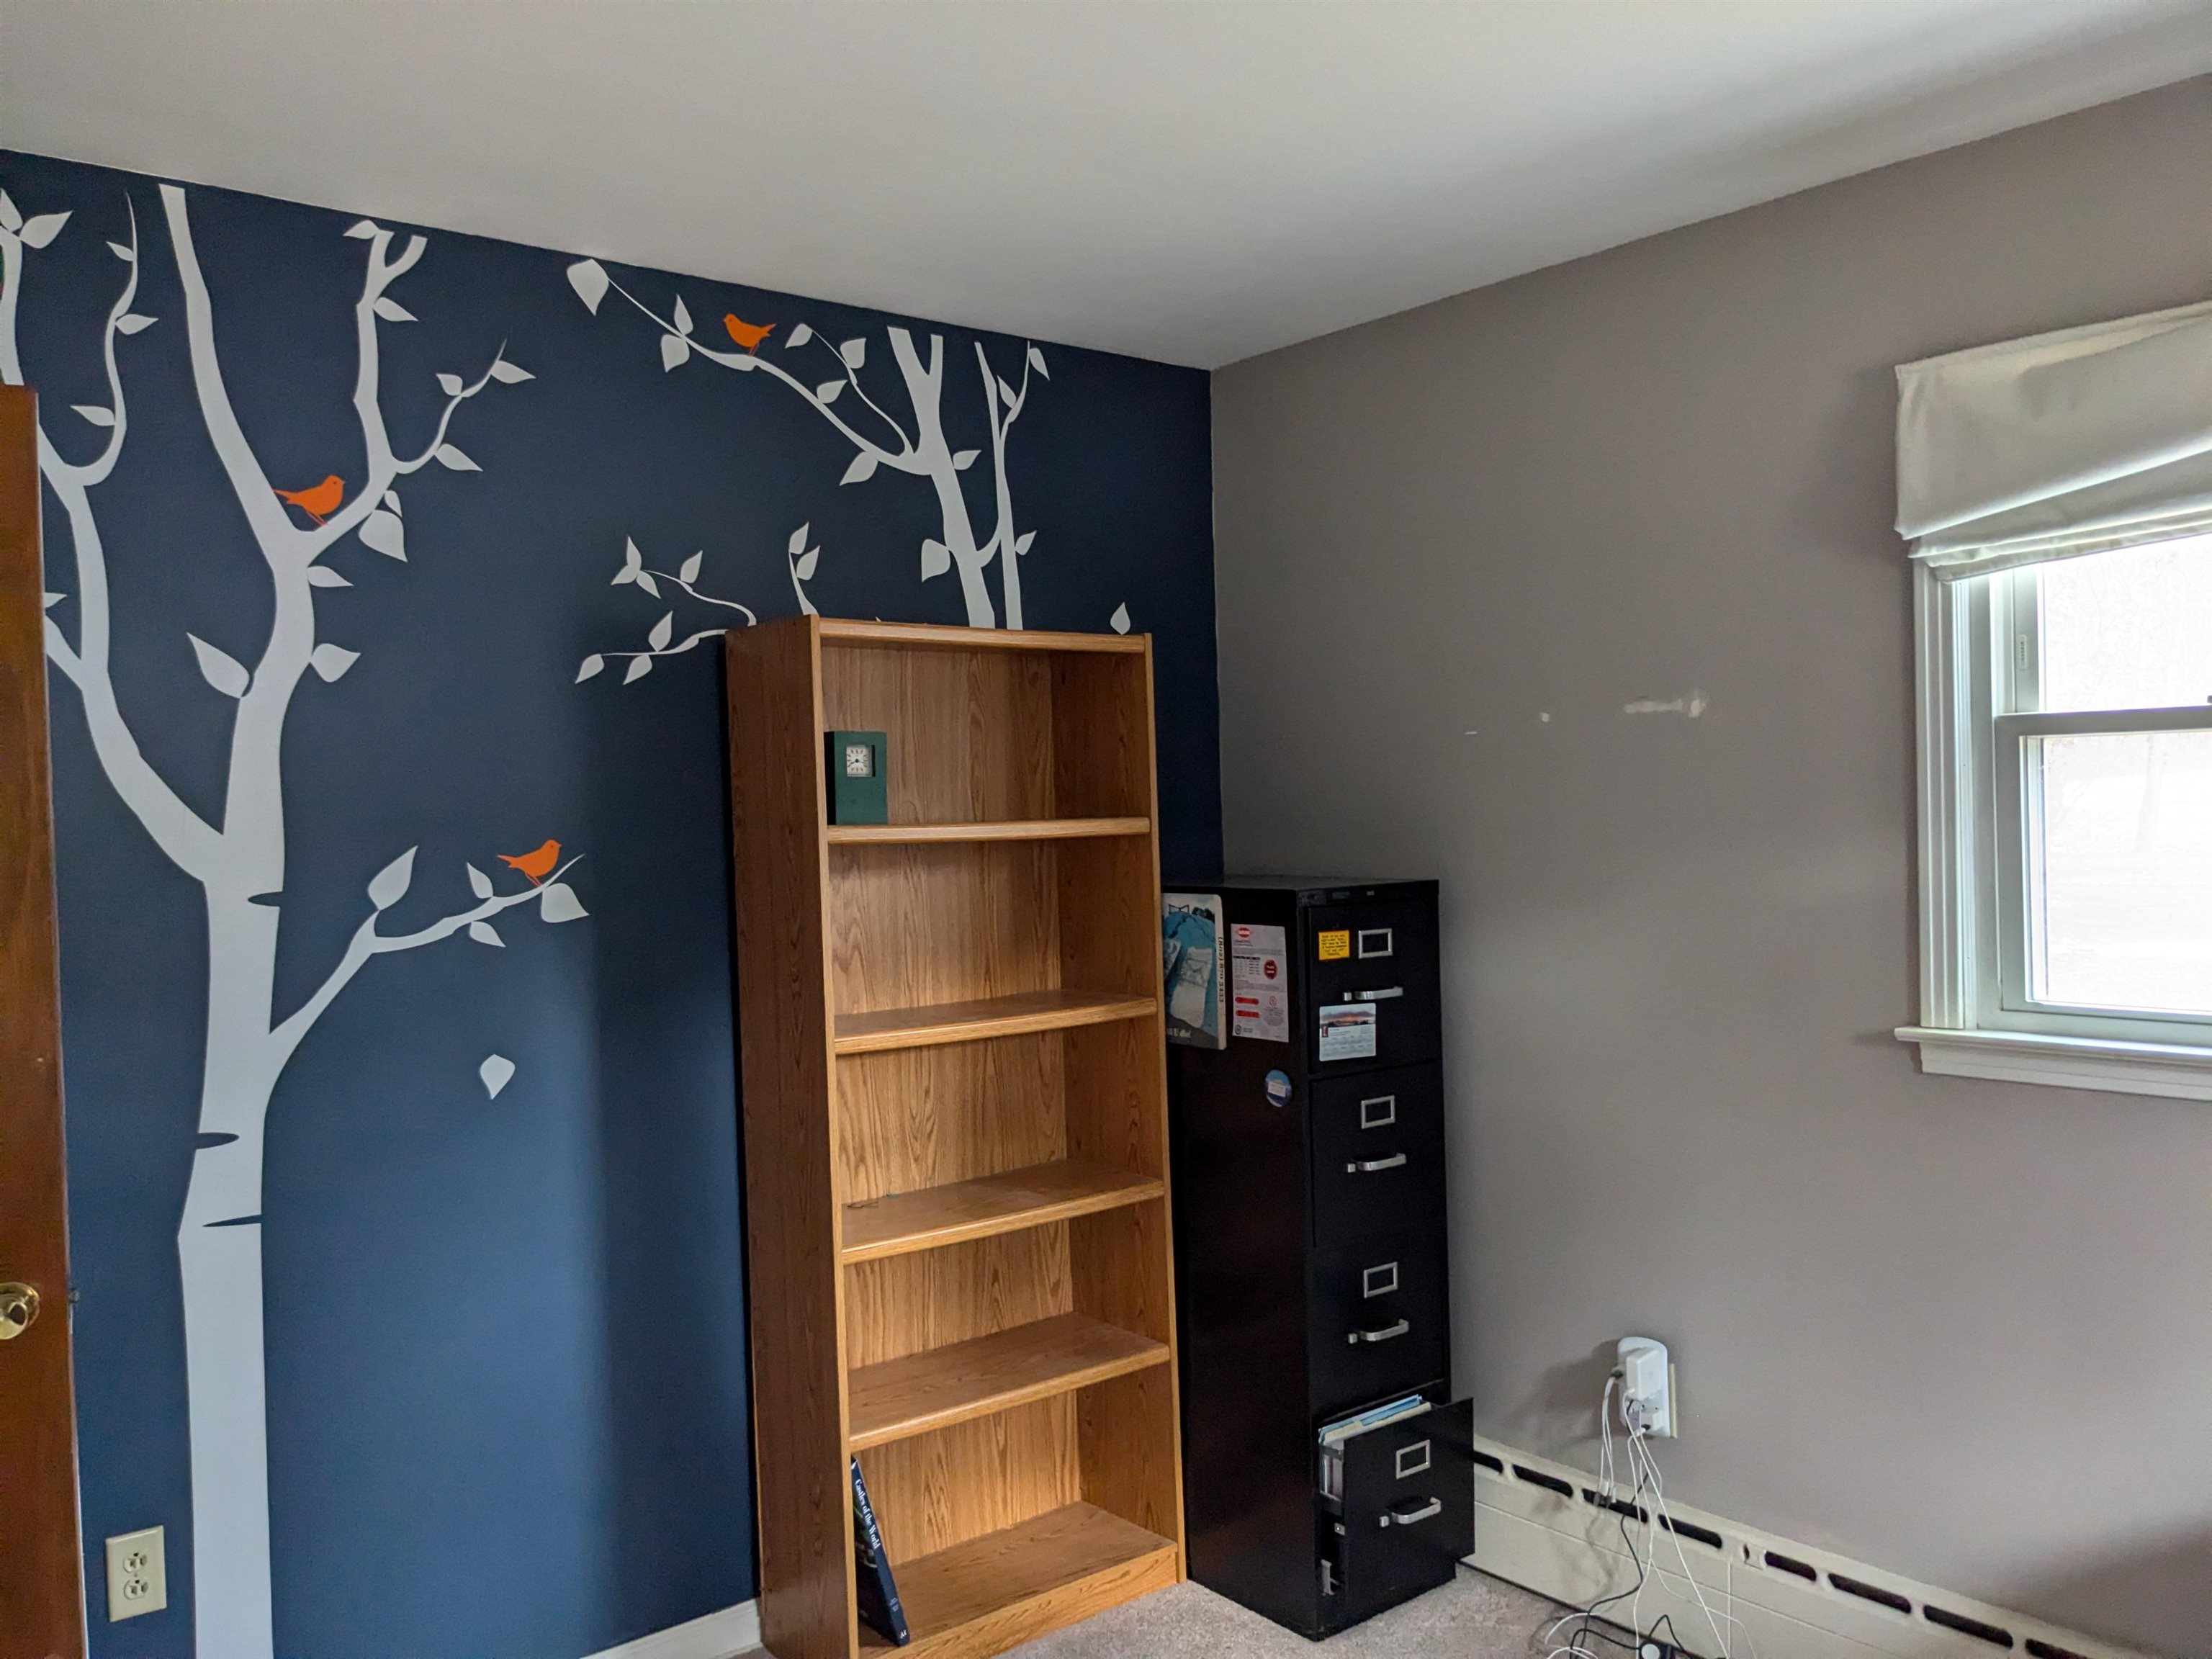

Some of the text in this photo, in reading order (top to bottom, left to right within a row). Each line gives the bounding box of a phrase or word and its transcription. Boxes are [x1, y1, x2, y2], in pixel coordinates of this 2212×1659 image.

[855, 1478, 866, 1506] Castles
[863, 1506, 871, 1514] of
[869, 1524, 881, 1550] World
